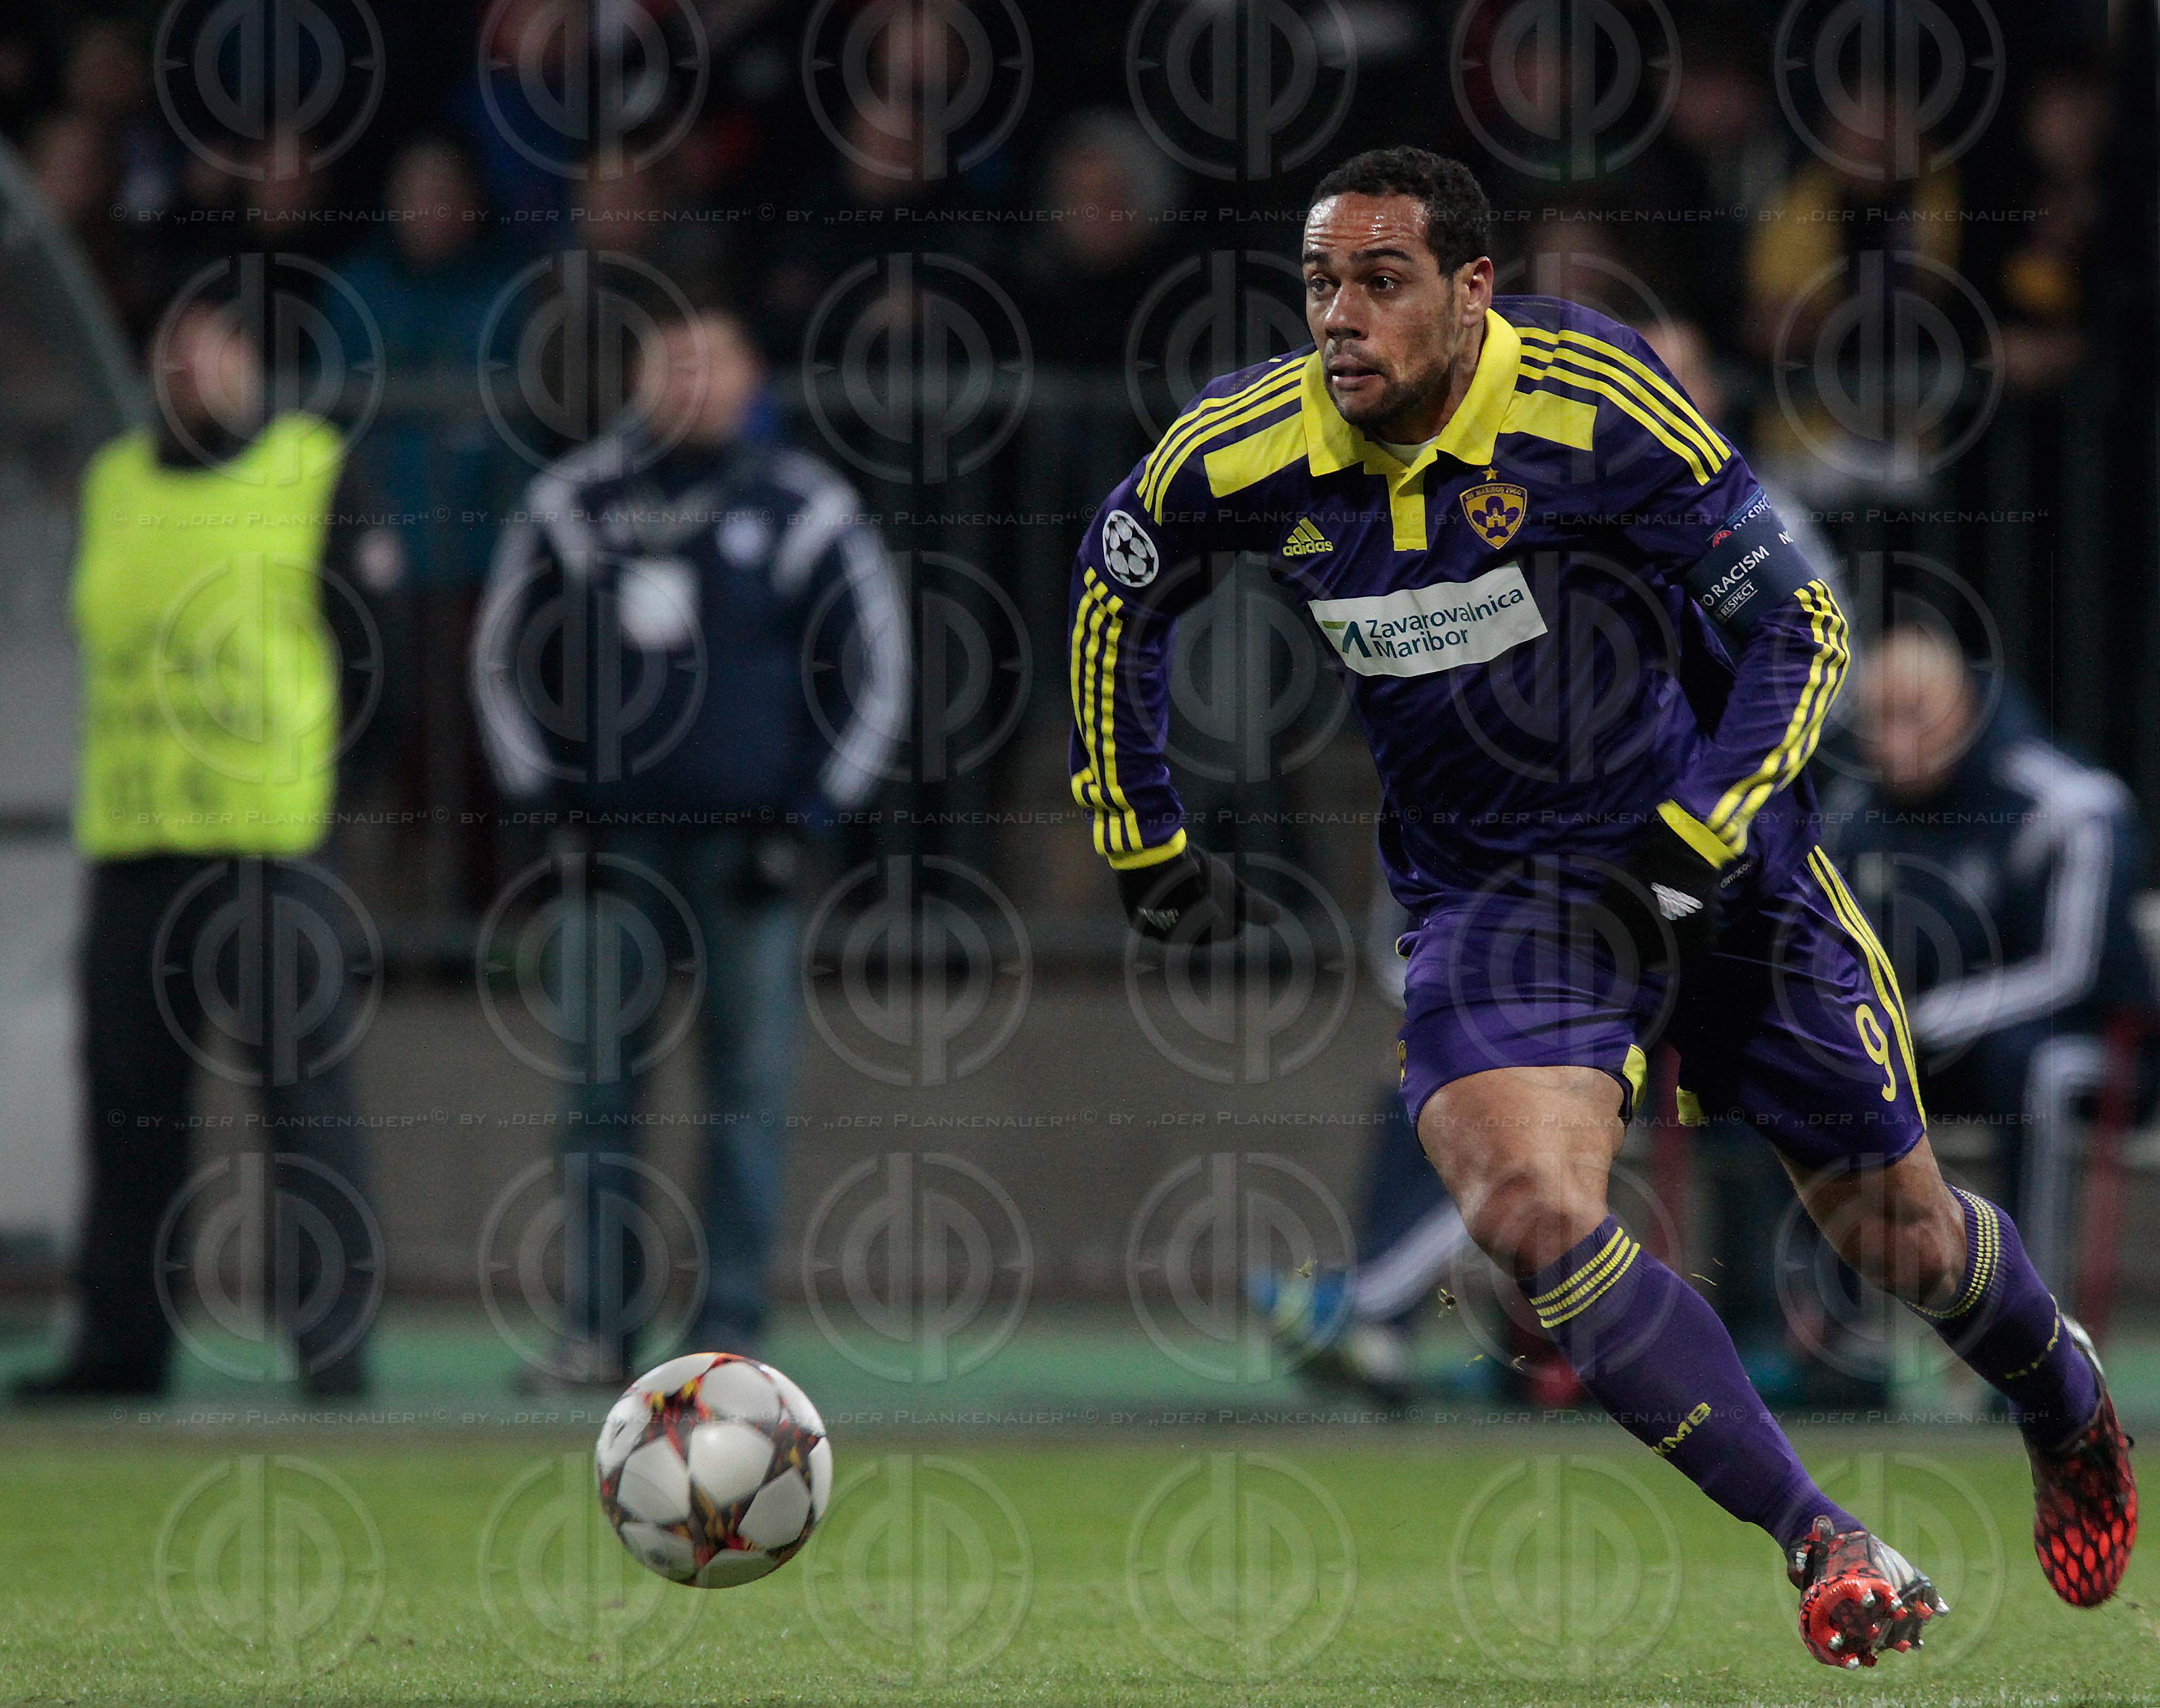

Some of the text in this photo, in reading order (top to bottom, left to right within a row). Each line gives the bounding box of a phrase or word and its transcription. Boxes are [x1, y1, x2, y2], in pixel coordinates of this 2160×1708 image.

[1283, 540, 1333, 556] adidas
[1711, 545, 1770, 597] RACISM
[1365, 588, 1524, 638] Zavarovalnica
[1720, 582, 1754, 616] RESPECT
[1372, 629, 1468, 659] Maribor
[1855, 1004, 1896, 1102] 9
